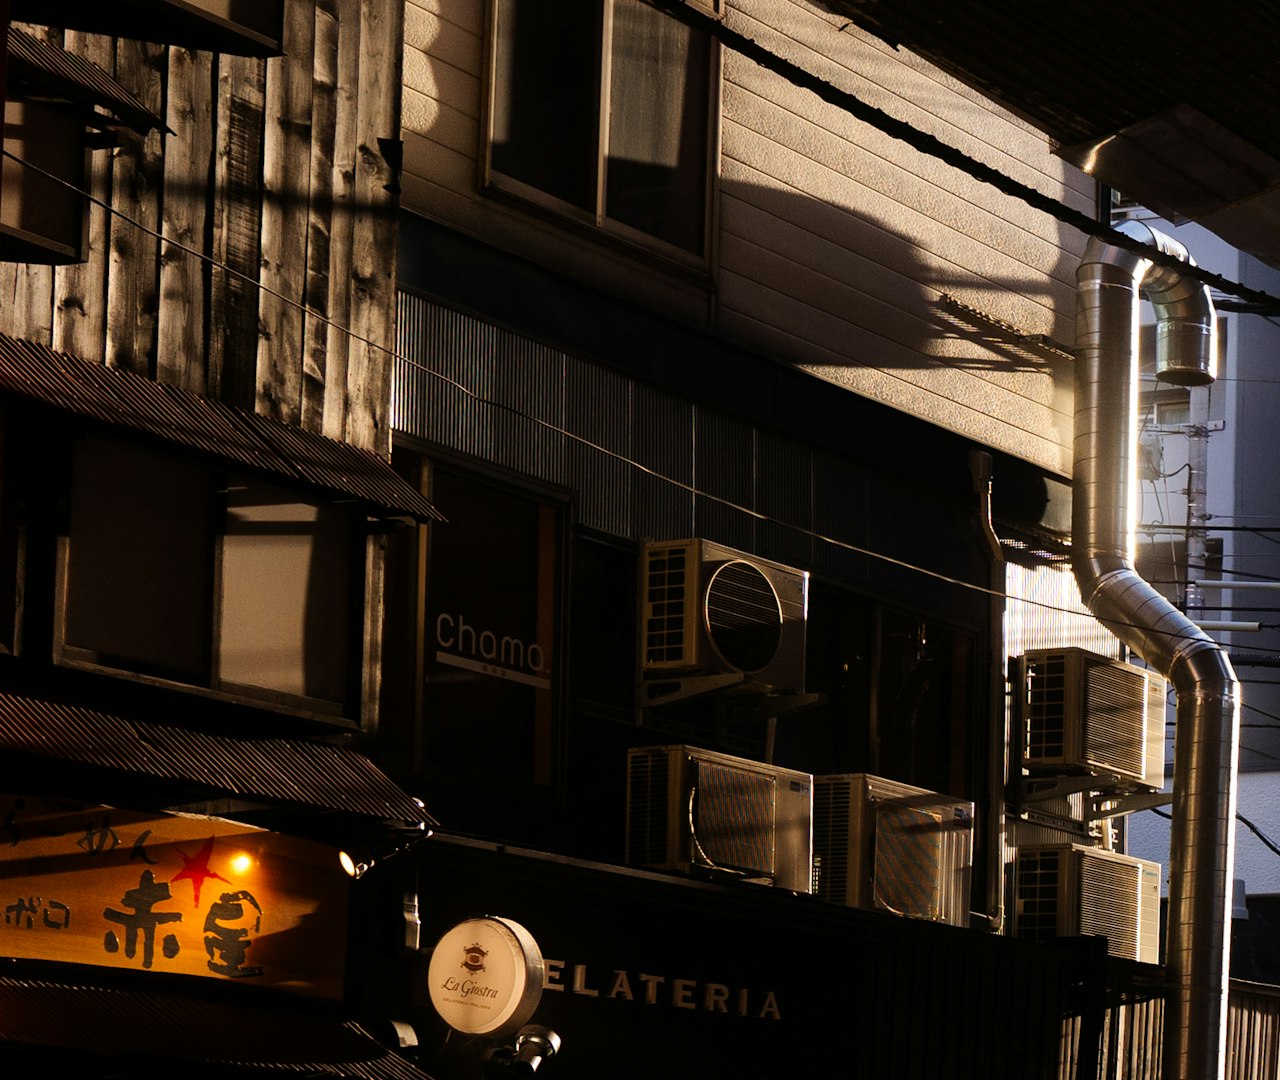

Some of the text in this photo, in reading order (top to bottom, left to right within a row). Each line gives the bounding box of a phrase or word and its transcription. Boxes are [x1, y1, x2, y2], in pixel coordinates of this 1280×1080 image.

[0, 896, 70, 930] ポロ
[103, 869, 265, 978] 赤星
[441, 976, 498, 999] La Giostra
[543, 958, 785, 1022] ELATERIA
